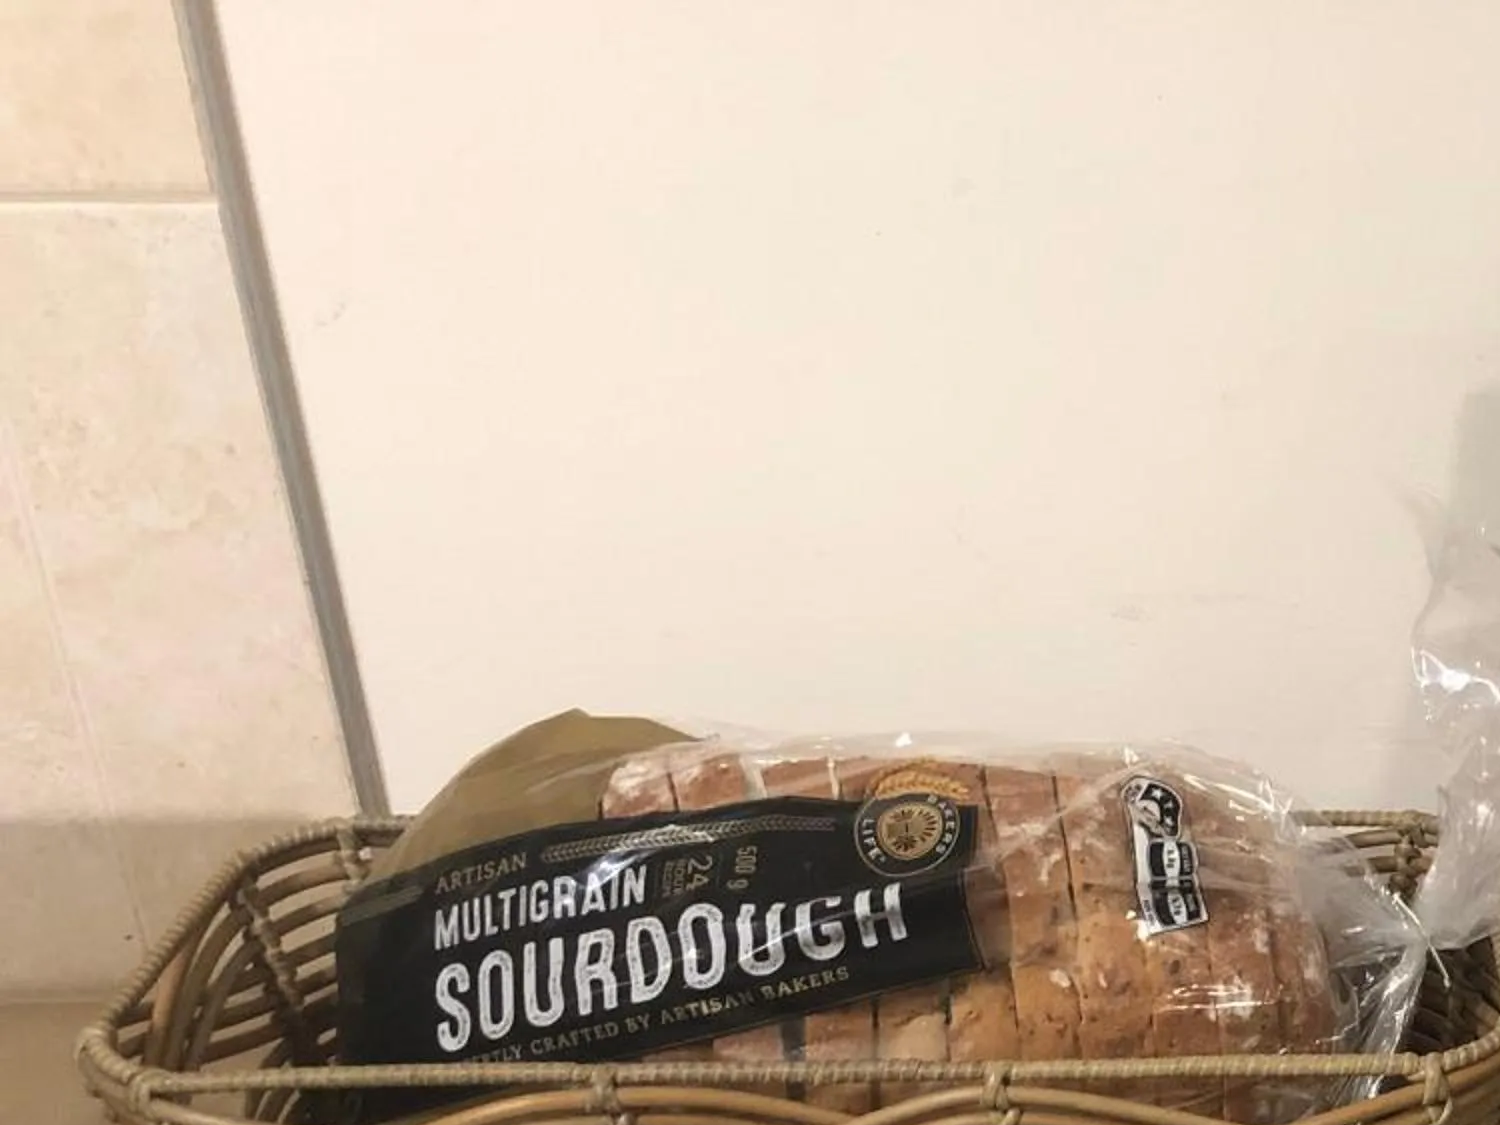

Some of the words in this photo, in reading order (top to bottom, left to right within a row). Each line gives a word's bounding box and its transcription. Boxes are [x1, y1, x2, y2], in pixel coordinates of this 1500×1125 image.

[434, 851, 528, 895] ARTISAN
[686, 855, 714, 892] 24
[734, 845, 759, 876] 500
[433, 865, 648, 950] MULTIGRAIN
[434, 882, 909, 1052] SOURDOUGH
[530, 1022, 620, 1056] CRAFTED
[625, 1012, 650, 1035] BY
[660, 991, 753, 1026] ARTISAN
[760, 965, 851, 1000] BAKERS
